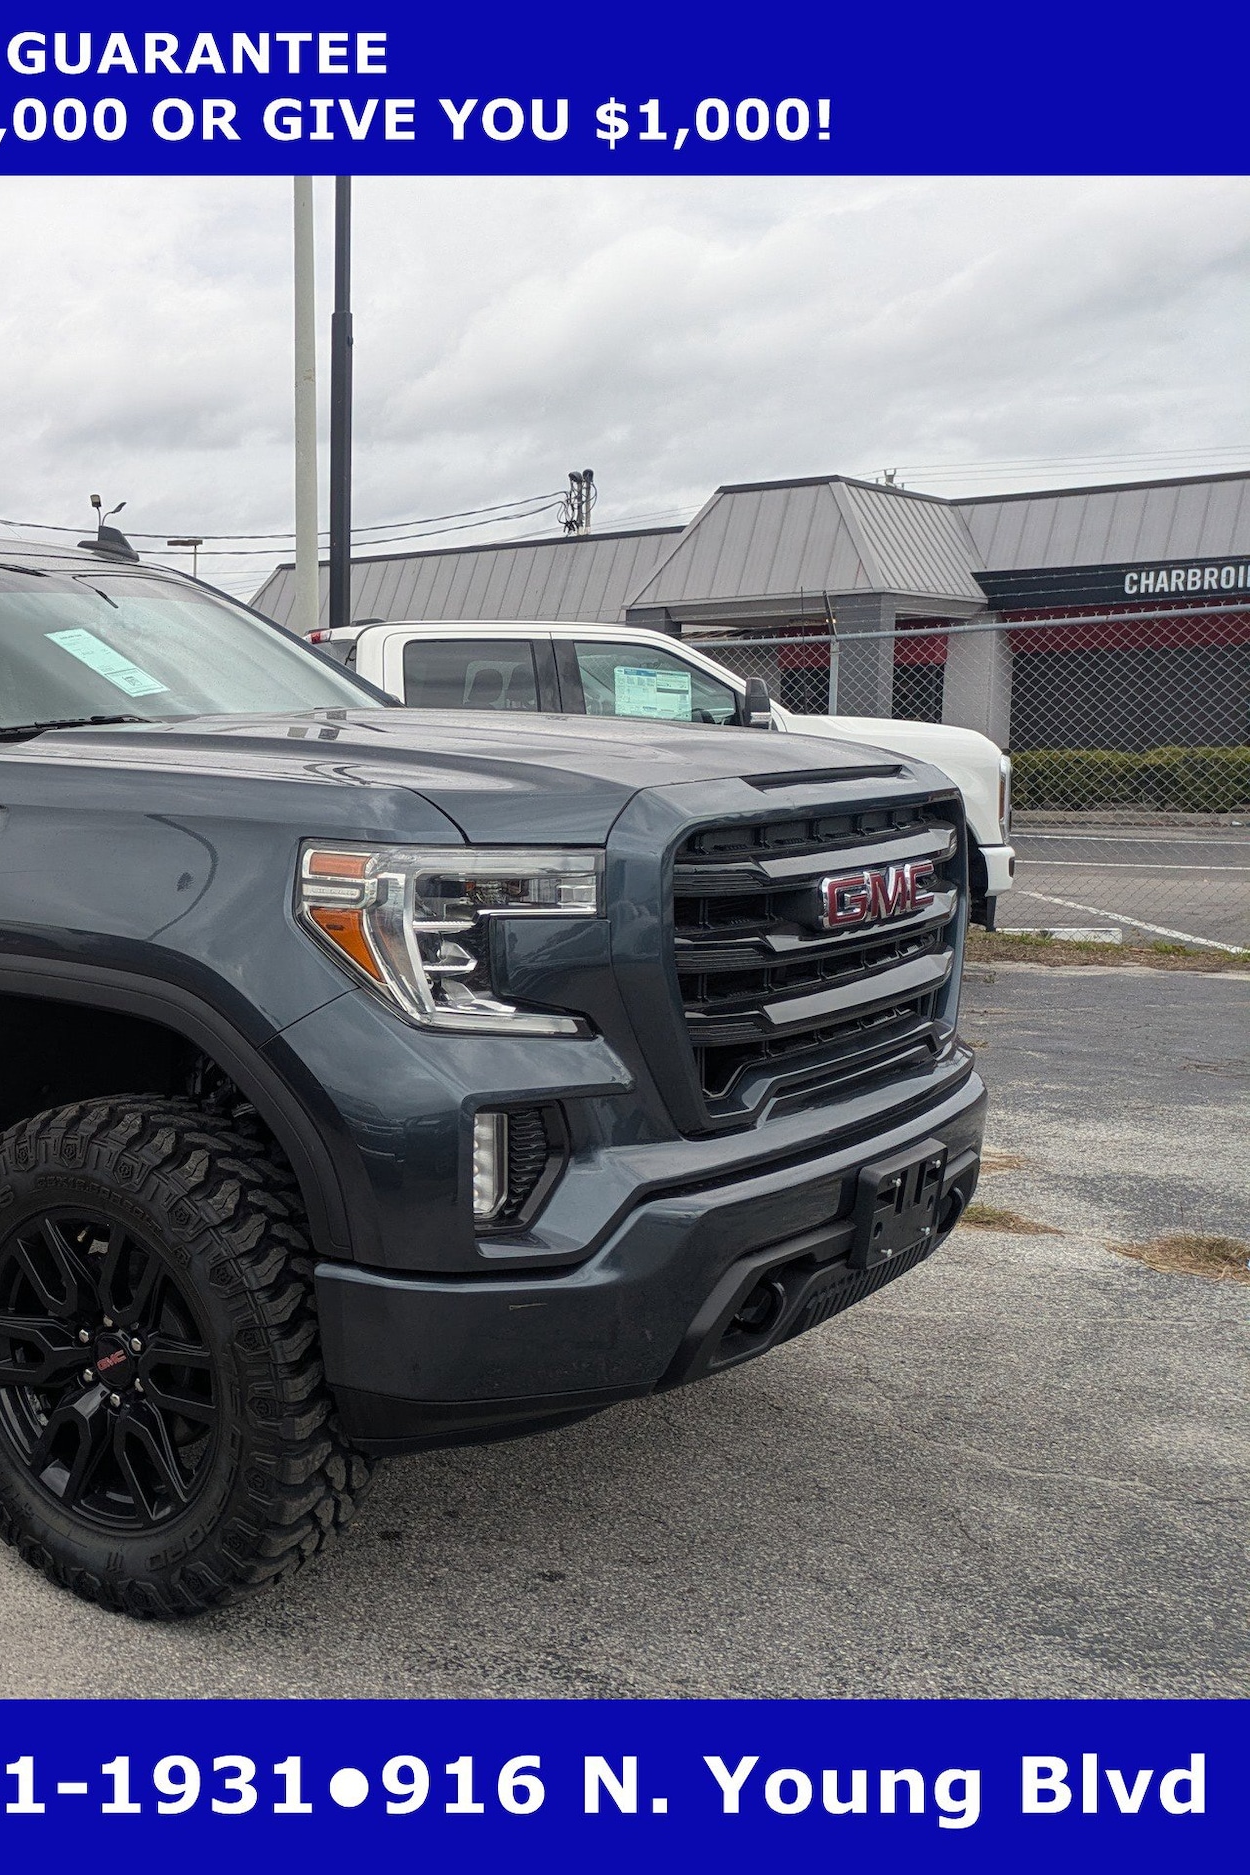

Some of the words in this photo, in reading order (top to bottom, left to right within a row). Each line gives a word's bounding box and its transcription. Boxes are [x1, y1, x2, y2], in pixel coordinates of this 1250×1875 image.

[1124, 565, 1250, 594] CHARBROI
[822, 859, 935, 928] GMC
[96, 1349, 127, 1371] GMC
